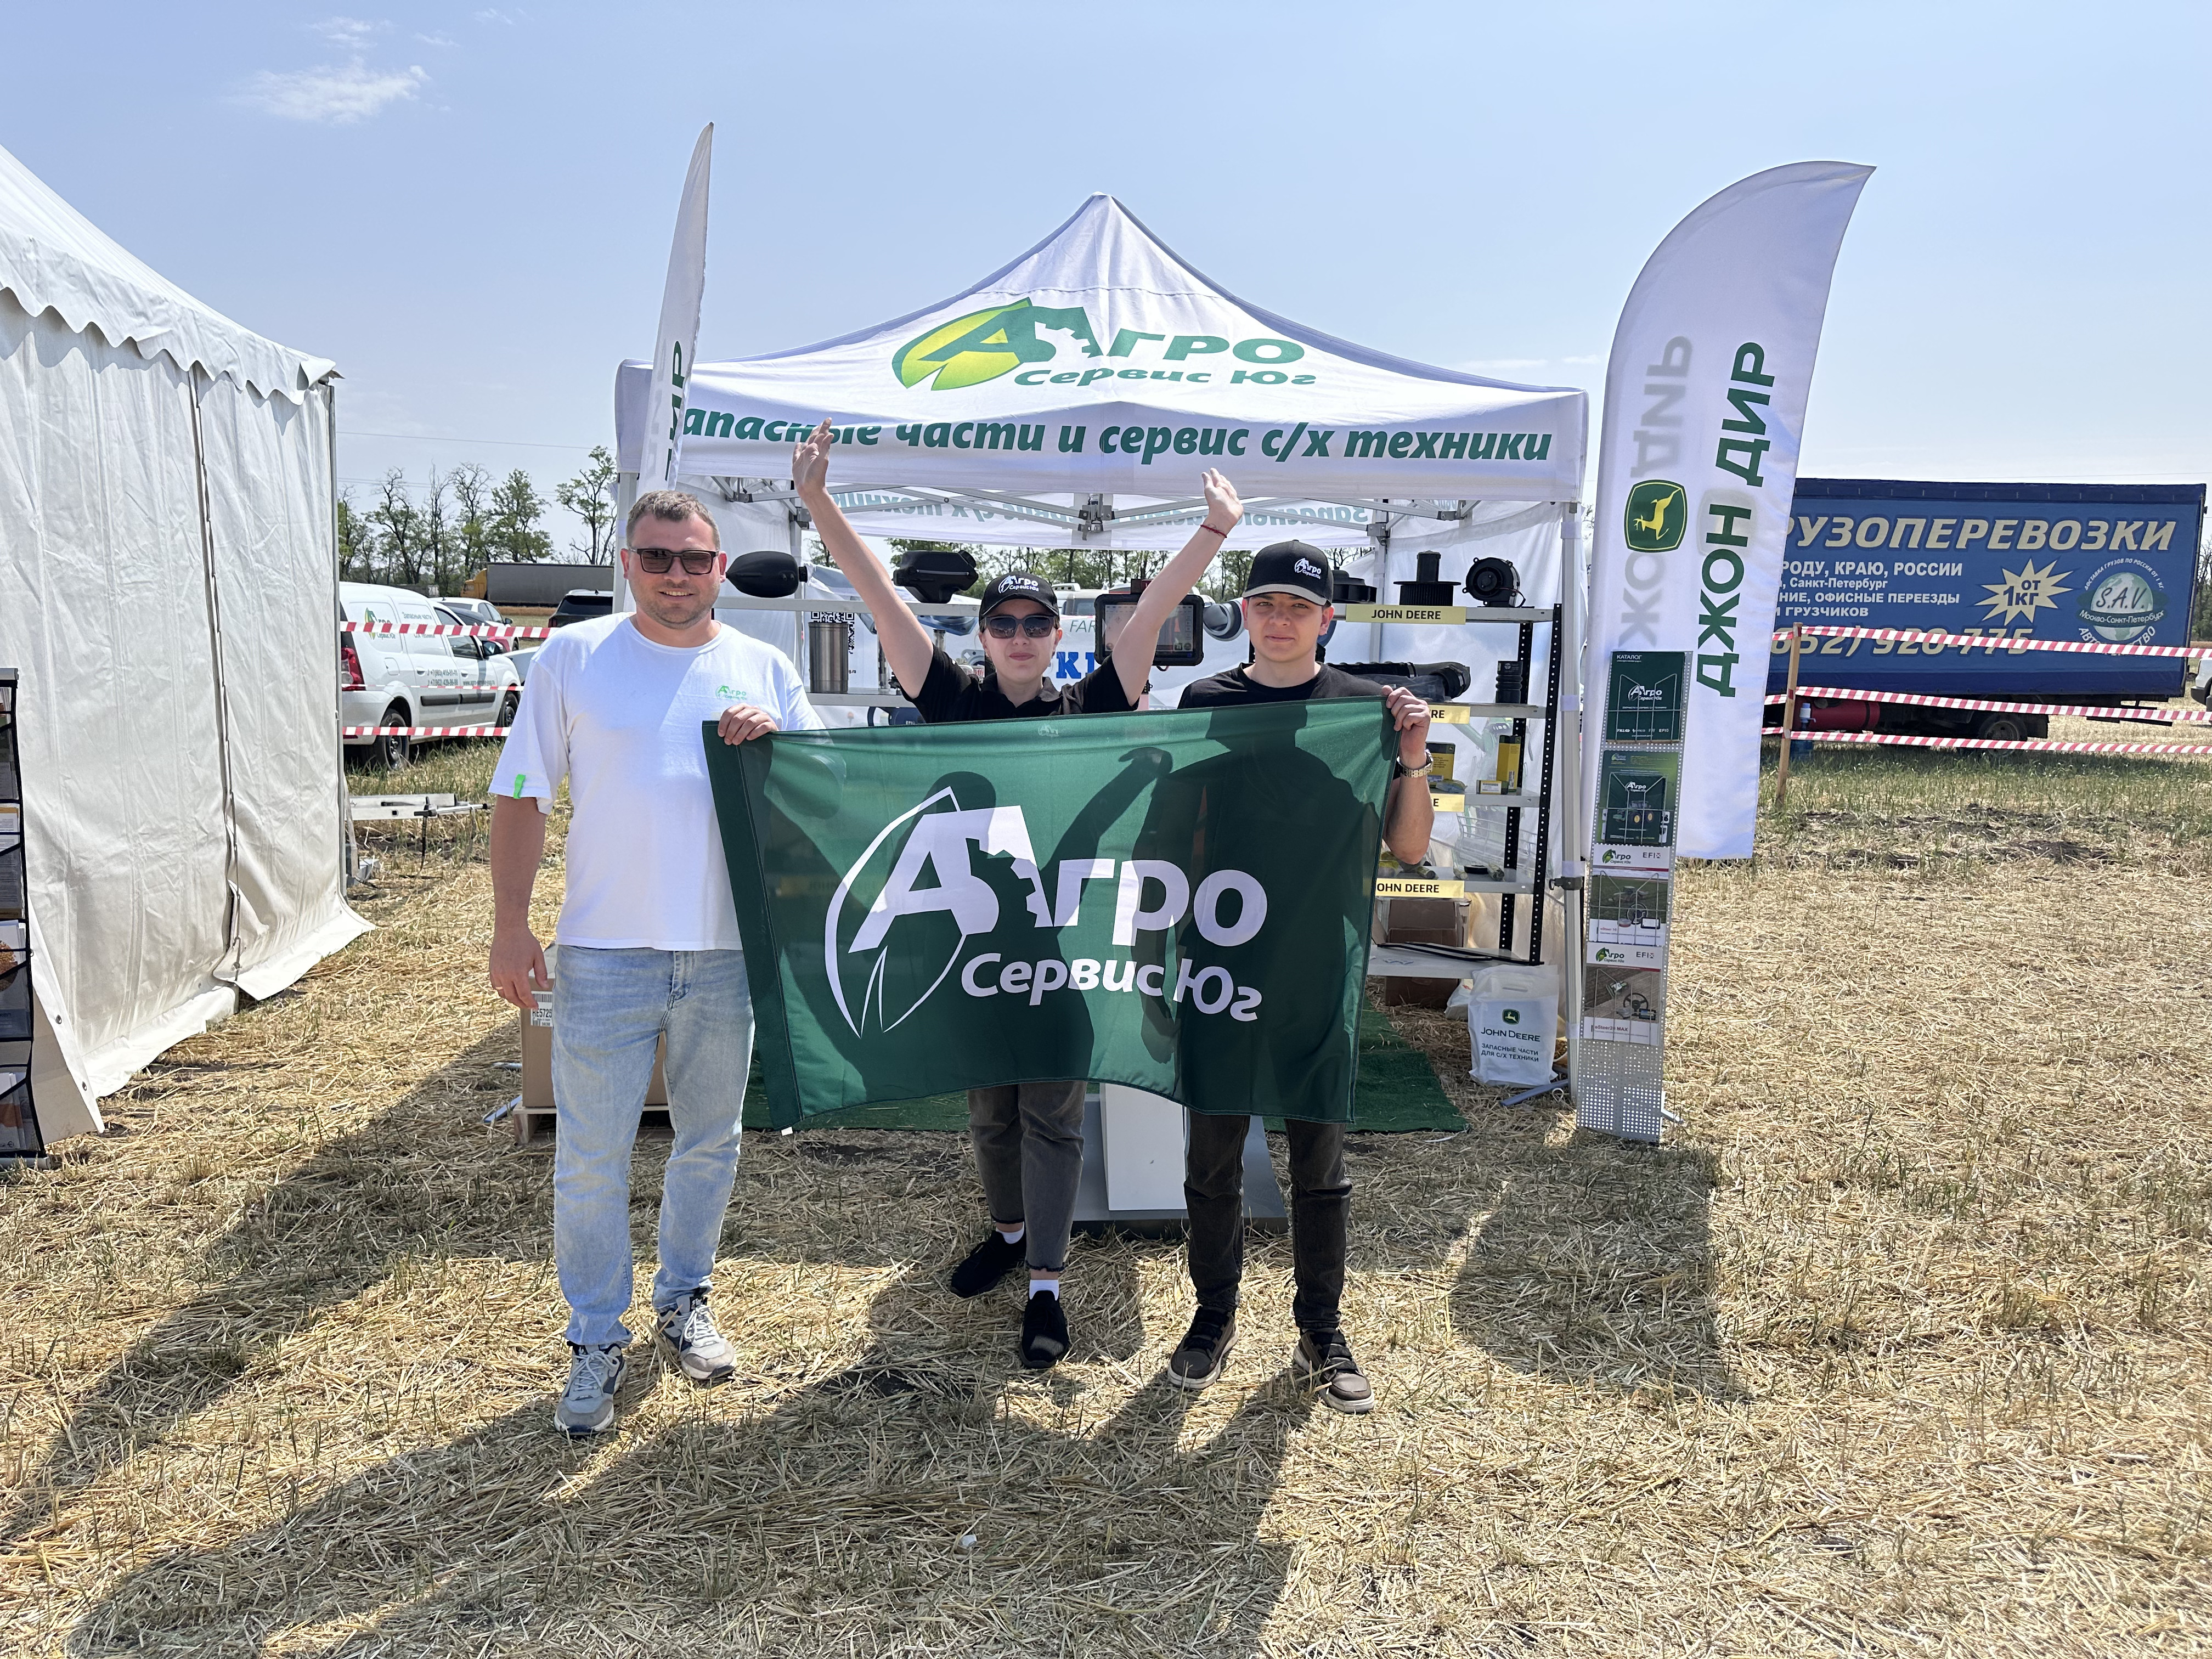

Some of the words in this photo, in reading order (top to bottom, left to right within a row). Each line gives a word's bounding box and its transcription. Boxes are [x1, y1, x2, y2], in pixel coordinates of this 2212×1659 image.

[1014, 367, 1211, 387] Сервис
[1230, 370, 1316, 385] Юг
[1716, 342, 1775, 487] ДИР
[895, 422, 1042, 451] части
[1058, 425, 1087, 453] и
[1099, 424, 1246, 464] сервис
[1262, 422, 1334, 462] с/х
[1344, 429, 1553, 460] техники
[1787, 516, 2177, 551] УЗОПЕРЕВОЗКИ
[1782, 561, 1830, 578] РОДУ,
[1835, 561, 1888, 578] КРАЮ,
[1894, 562, 1962, 577] РОССИИ
[1790, 577, 1888, 591] Санкт-Петербург
[1696, 503, 1751, 697] ДЖОН
[1779, 592, 1811, 605] НИЕ,
[1815, 592, 1884, 603] ОФИСНЫЕ
[1888, 593, 1960, 606] ПЕРЕЕЗДЫ
[1372, 609, 1403, 619] JOHN
[1406, 610, 1442, 620] DEERE
[1785, 606, 1869, 617] ГРУЗЧИКОВ
[1070, 619, 1096, 633] FAR
[1376, 883, 1402, 892] OHN
[1405, 884, 1440, 893] DEERE
[962, 952, 1164, 1006] Сервис
[1173, 959, 1262, 1022] Юг
[1481, 1026, 1506, 1037] JOHN
[1508, 1030, 1541, 1042] DEERE
[1481, 1043, 1516, 1053] ЗАПАСНЫЕ
[1518, 1047, 1538, 1056] ЧАСТИ
[1509, 1054, 1539, 1062] ТЕХНИКИ
